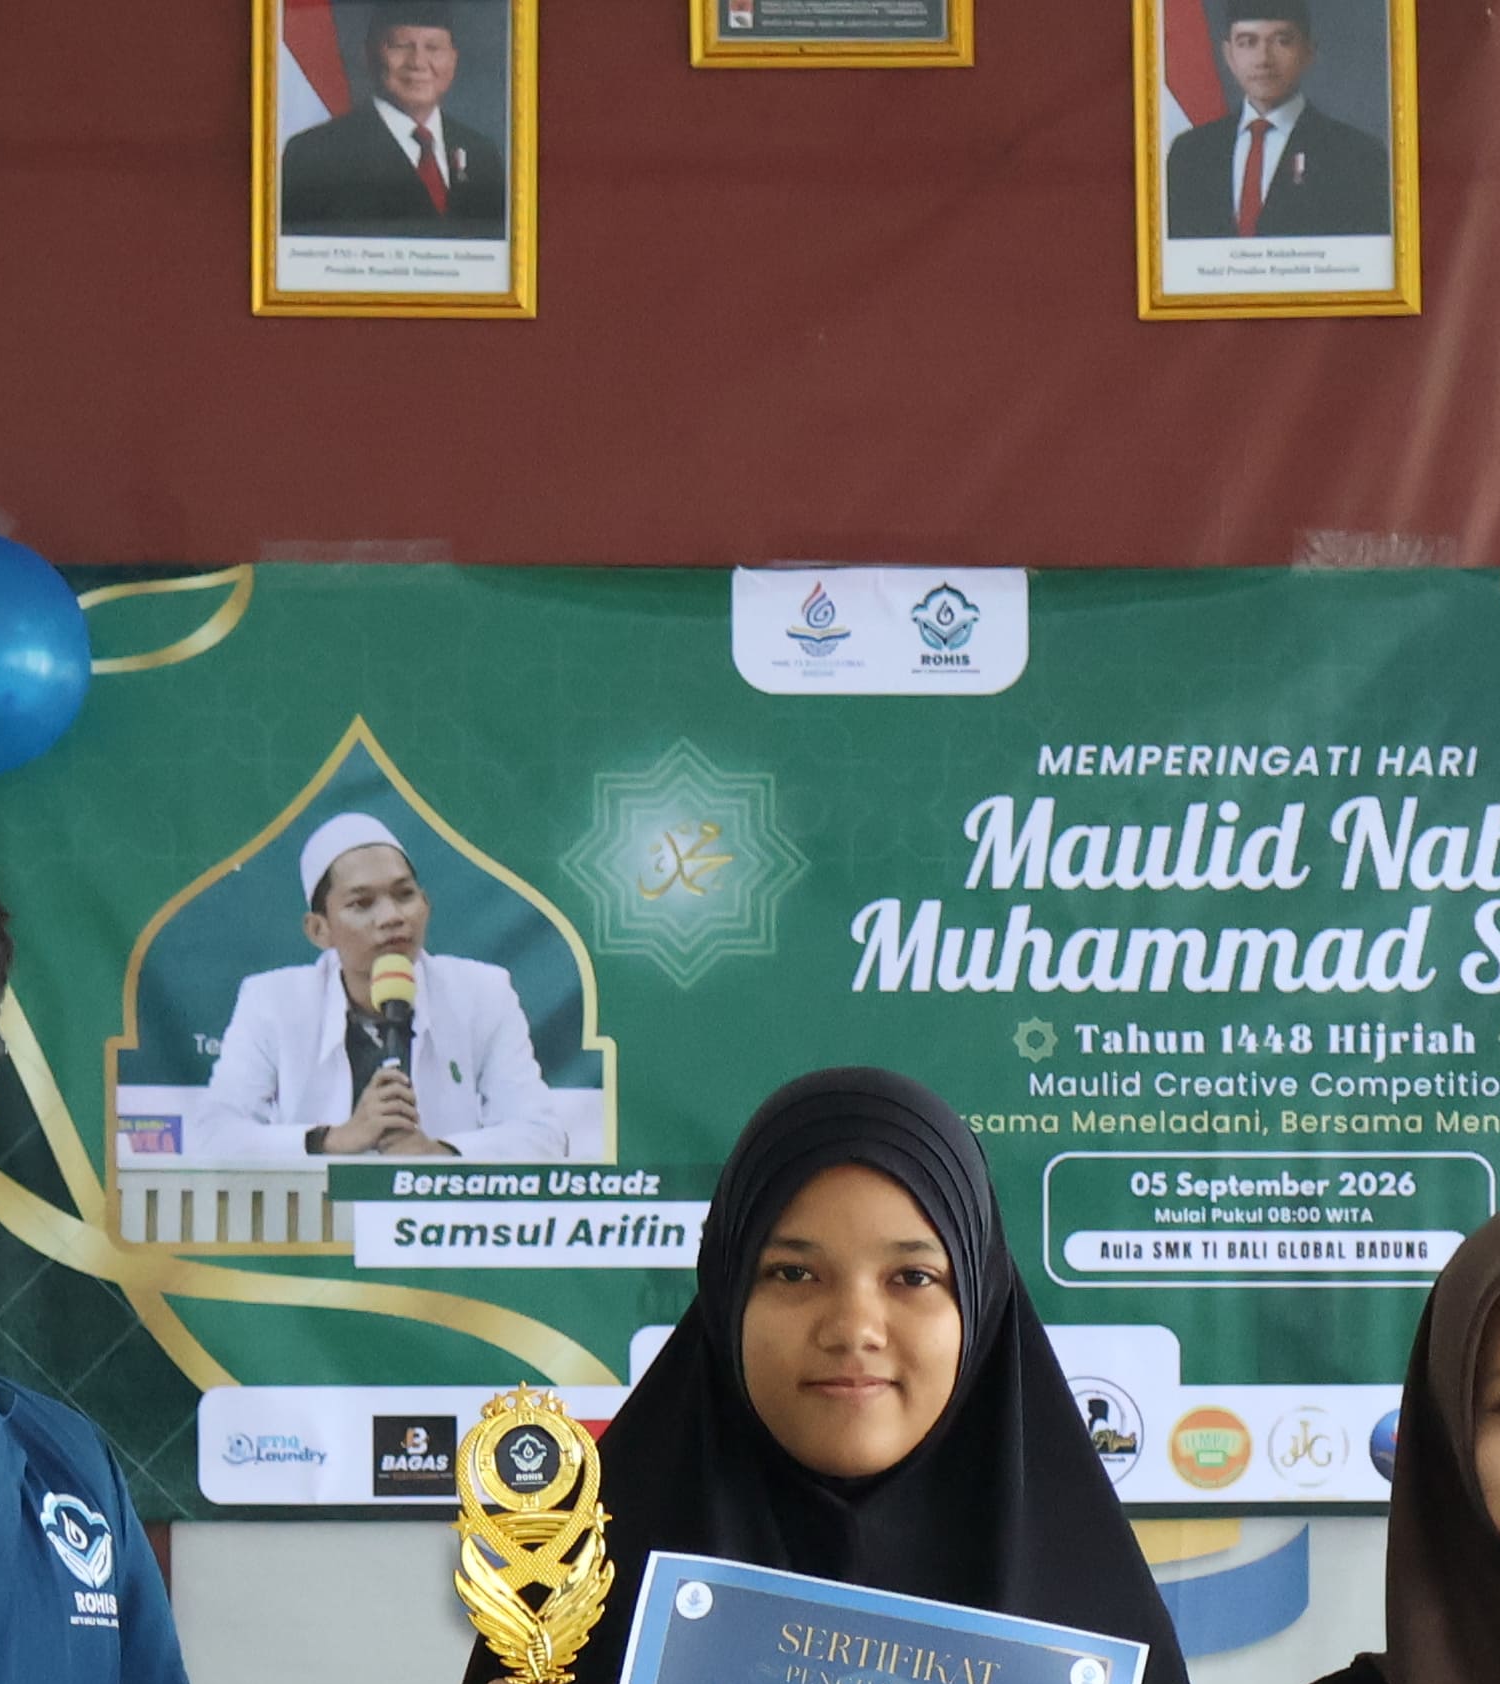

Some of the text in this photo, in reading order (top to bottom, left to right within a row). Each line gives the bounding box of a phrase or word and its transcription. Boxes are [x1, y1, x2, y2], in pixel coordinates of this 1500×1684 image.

[920, 654, 971, 666] ROHIS
[1038, 745, 1477, 777] MEMPERINGATI HARI
[964, 794, 1310, 893] Maulid
[851, 898, 1437, 995] Muhammad
[1075, 1023, 1476, 1063] Tahun 1448 Hijriah
[1029, 1073, 1141, 1098] Maulid
[1154, 1072, 1298, 1098] Creative
[961, 1111, 1059, 1134] sama
[1071, 1109, 1270, 1137] Meneladani,
[1281, 1109, 1424, 1135] Bersama
[393, 1171, 660, 1196] Bersama Ustadz
[1130, 1172, 1416, 1204] 05 September 2026
[1154, 1206, 1374, 1225] Mulai Pukul 08:00 WITA
[394, 1218, 685, 1247] Samsul Arifin
[1100, 1240, 1429, 1261] Aula SMK TI BALI GLOBAL BADUNG
[257, 1447, 327, 1465] Laundry
[381, 1455, 449, 1471] BAGAS
[74, 1591, 118, 1615] ROHIS
